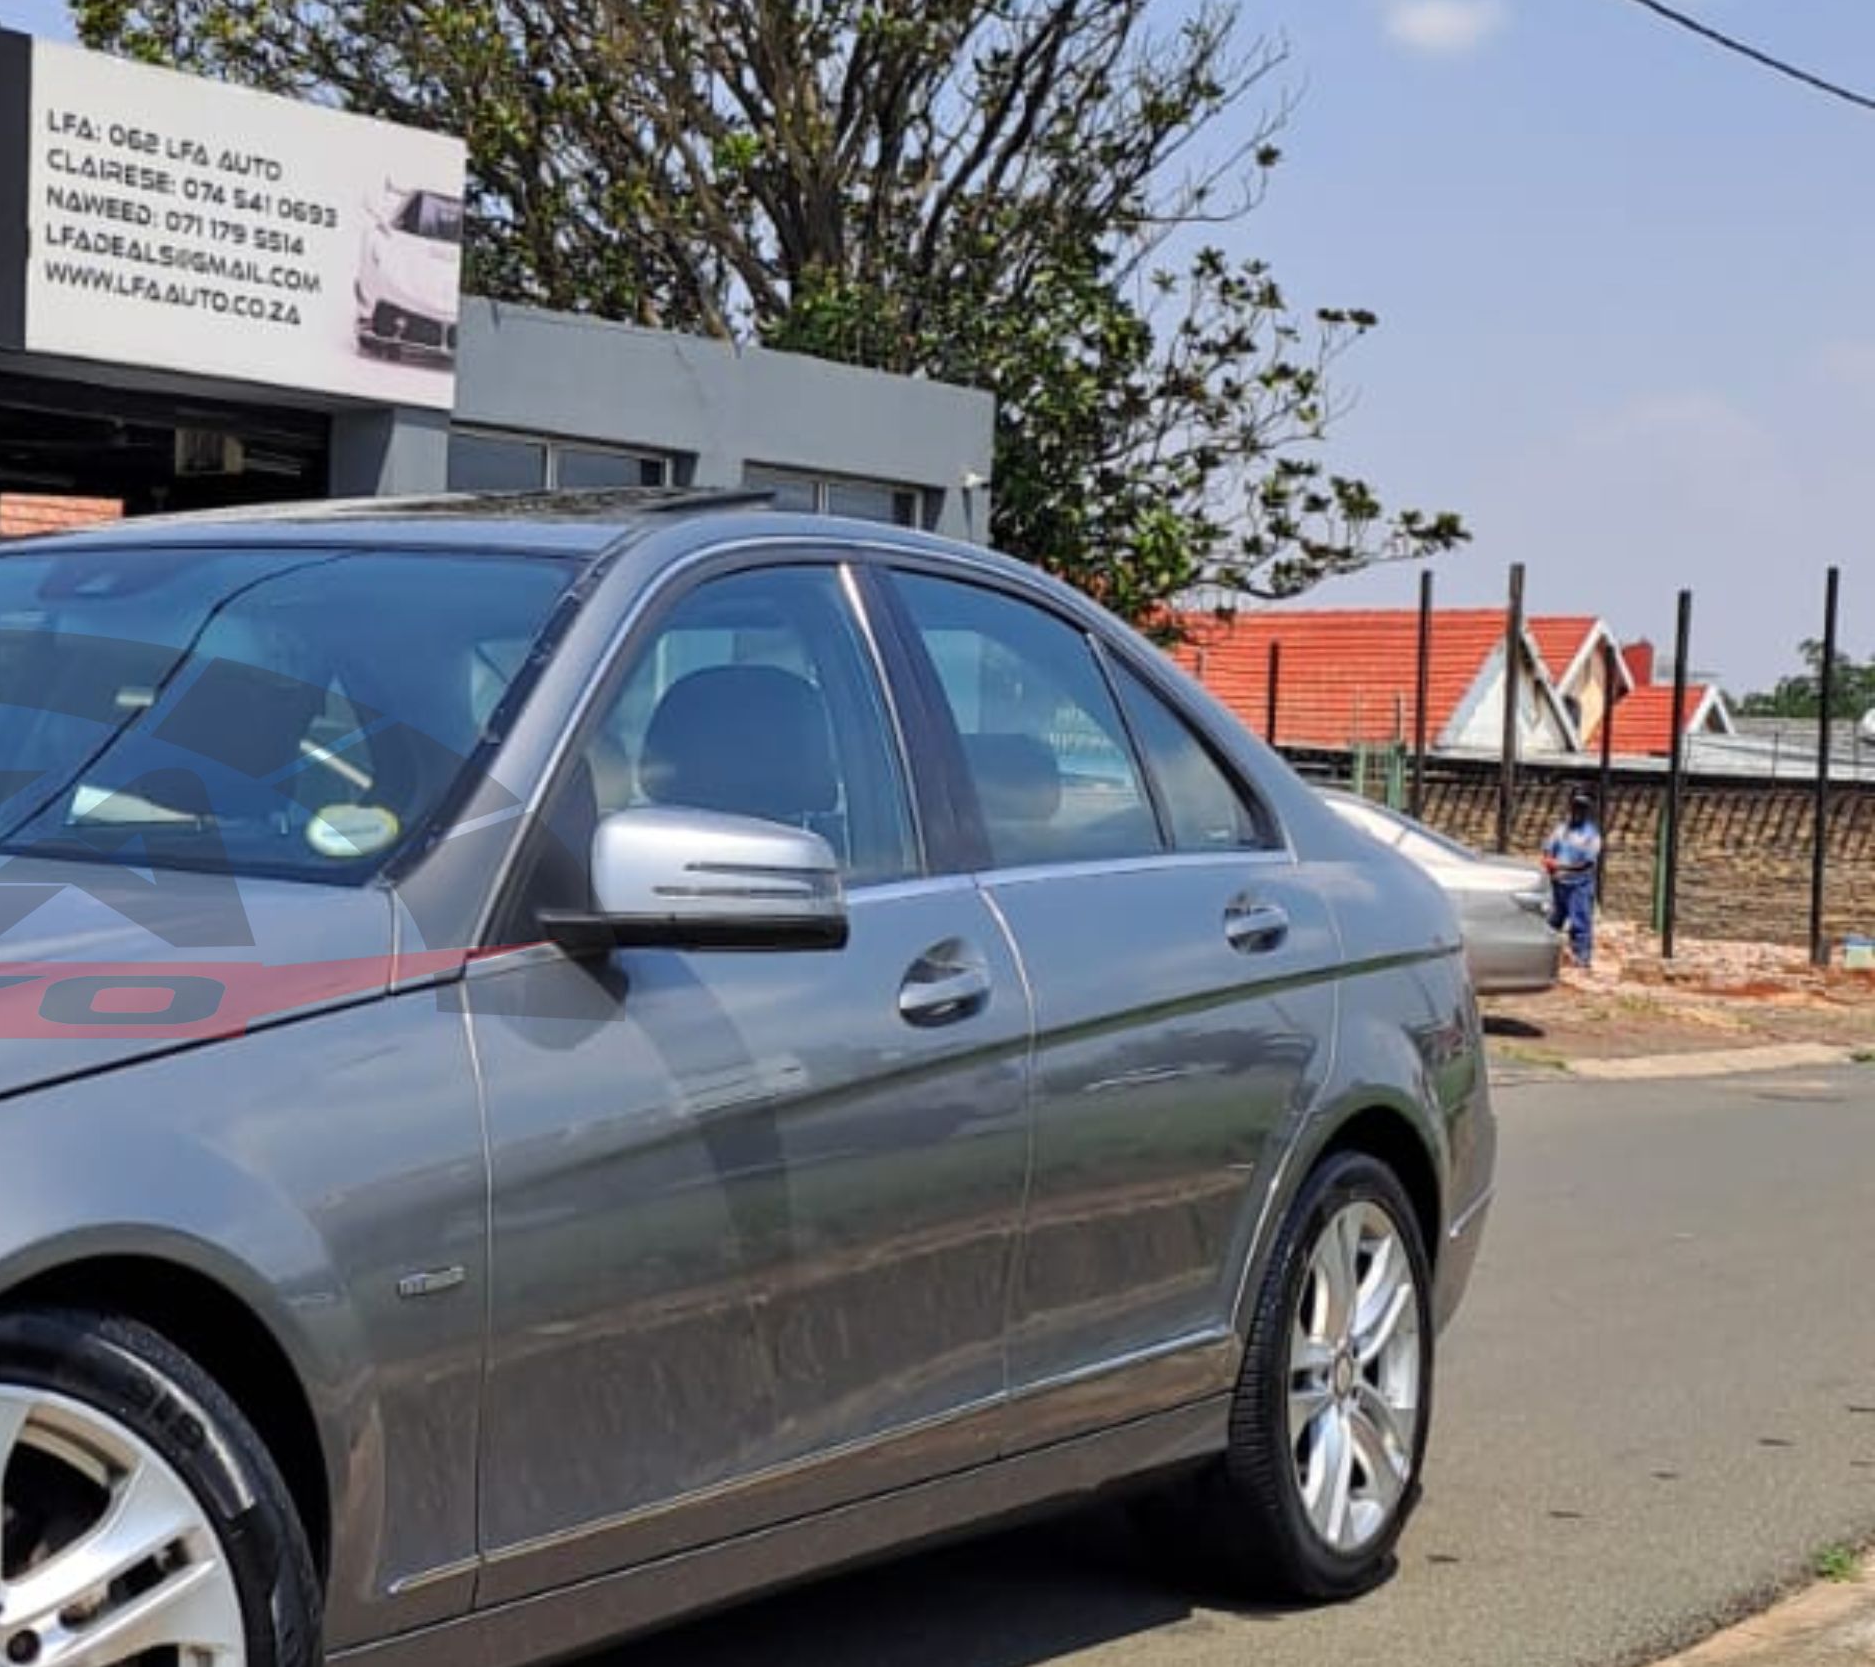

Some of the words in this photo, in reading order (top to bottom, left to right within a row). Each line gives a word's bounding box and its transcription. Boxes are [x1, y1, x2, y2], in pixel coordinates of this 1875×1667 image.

[47, 108, 101, 142] LFA:
[166, 137, 210, 166] LFA
[218, 149, 283, 181] AUTO
[183, 177, 227, 205] 074
[166, 211, 204, 237] 071
